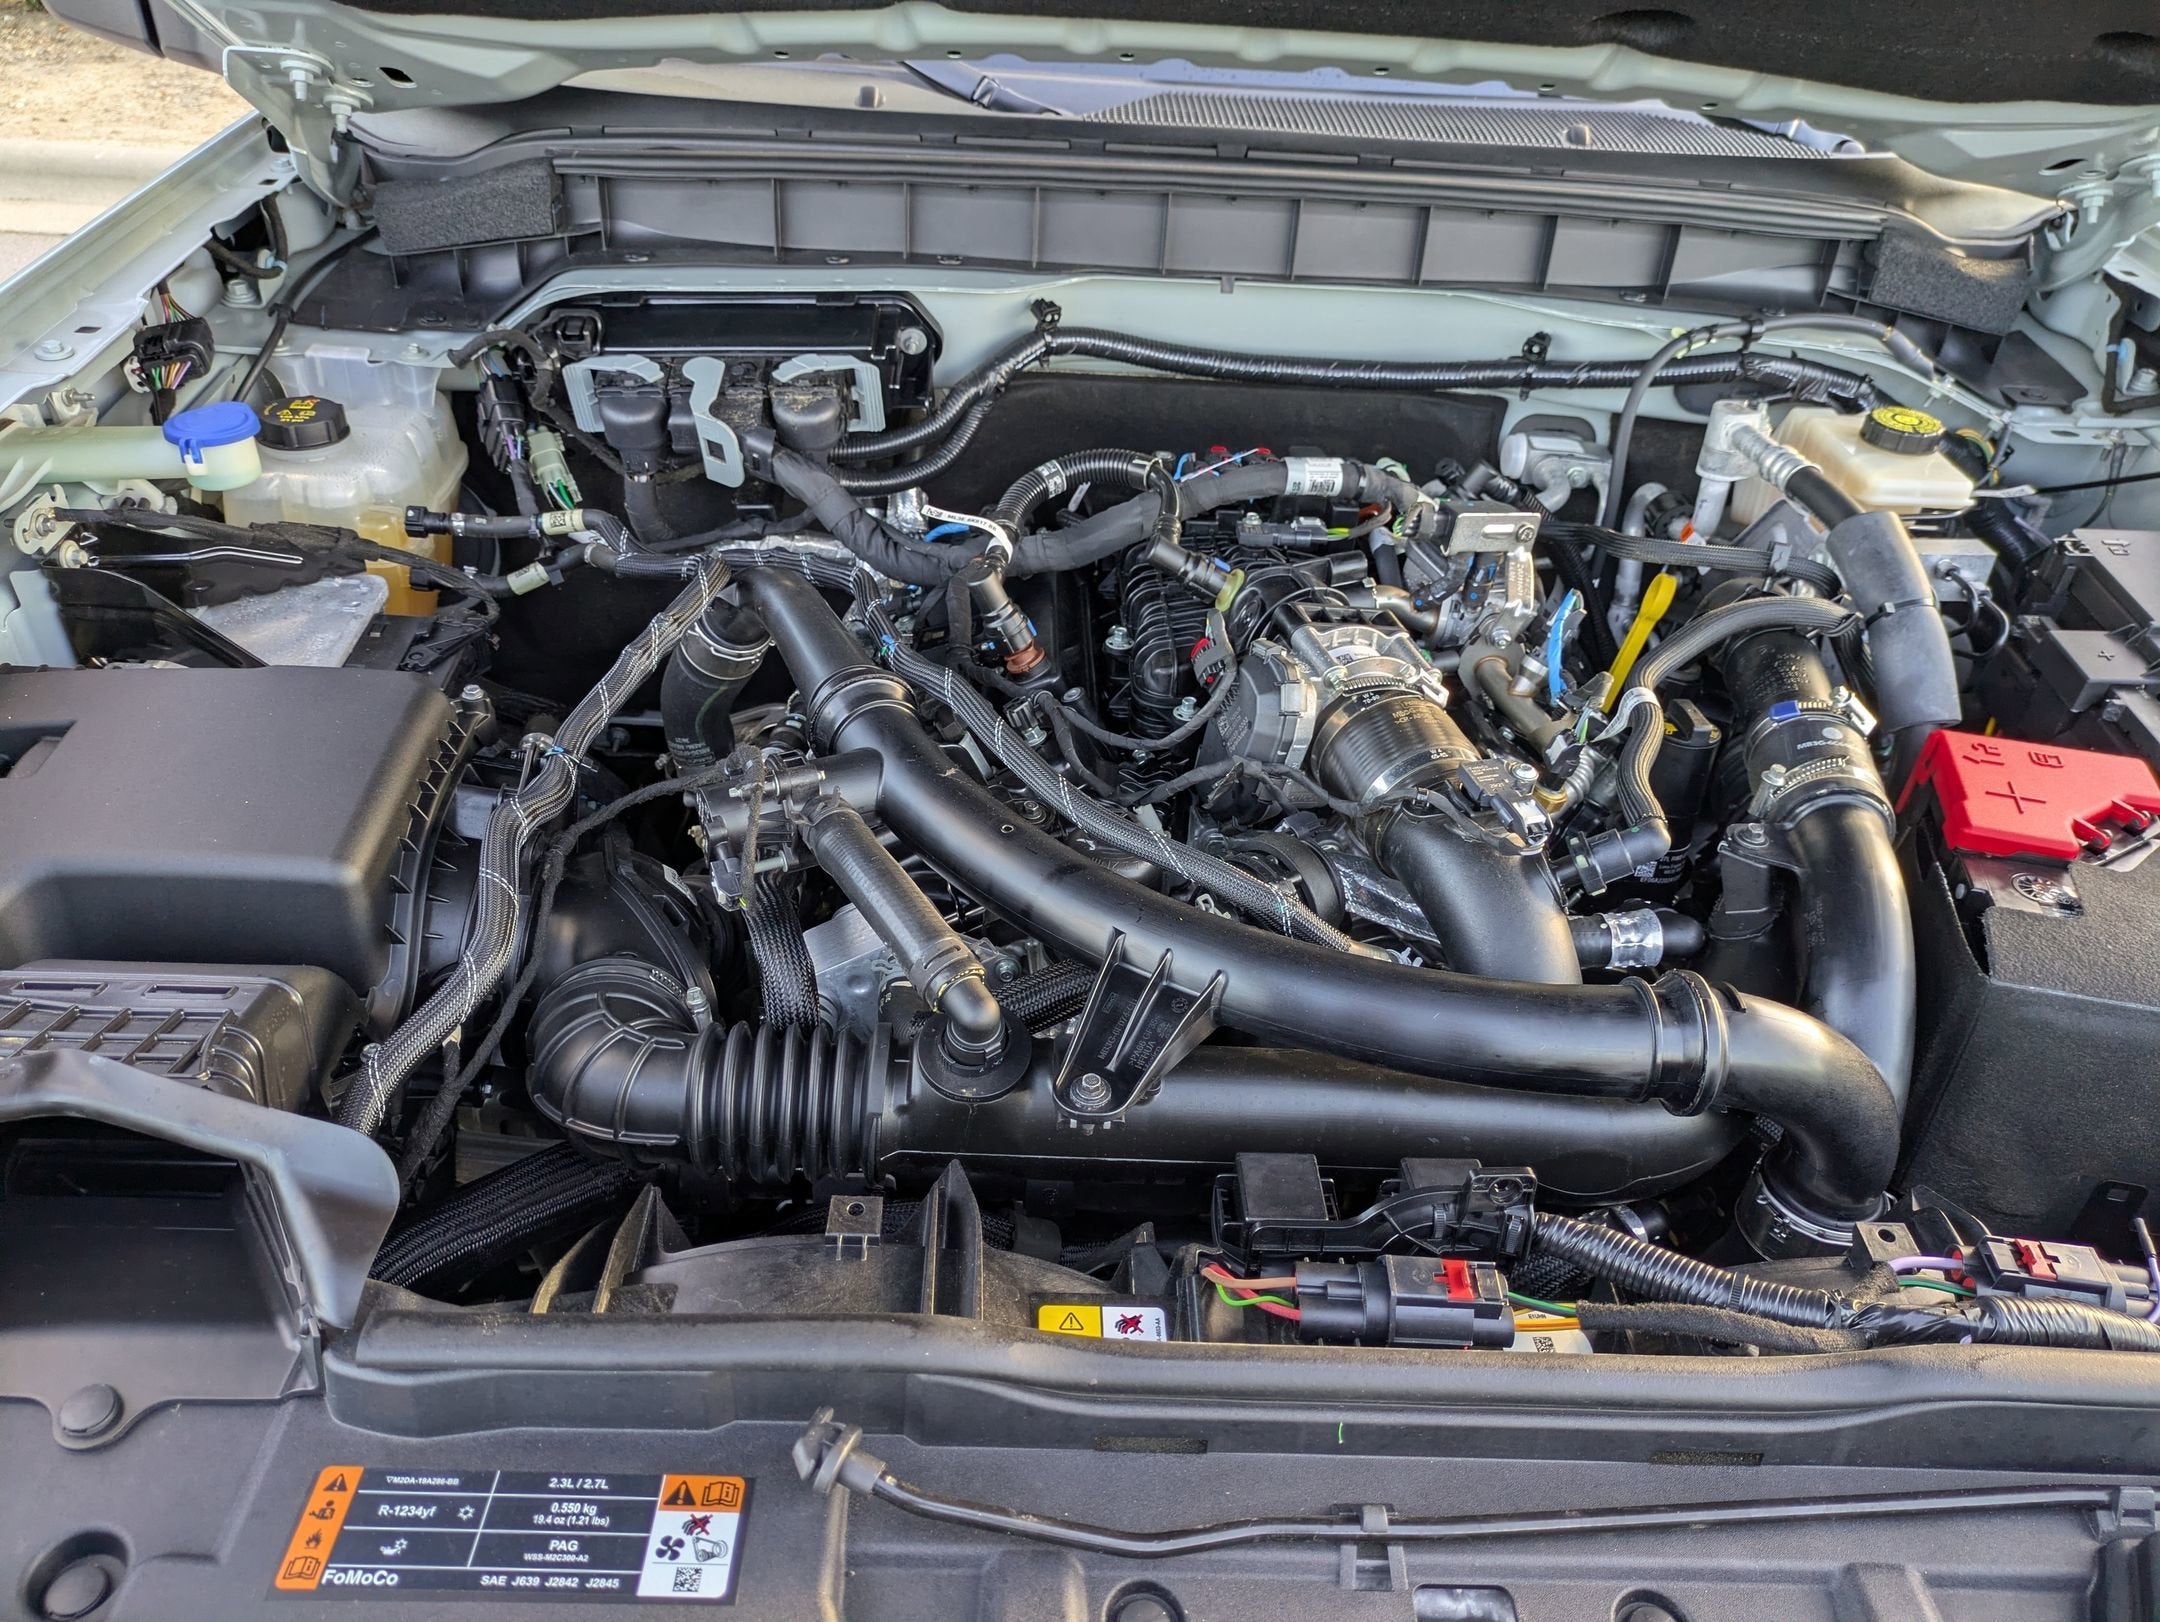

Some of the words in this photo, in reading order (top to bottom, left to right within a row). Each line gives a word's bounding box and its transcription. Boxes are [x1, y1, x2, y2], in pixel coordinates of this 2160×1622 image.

[548, 1478, 575, 1488] 2.3L
[583, 1479, 609, 1489] 2.7L
[378, 1504, 437, 1519] R-1234yf
[550, 1502, 581, 1513] 0.550
[583, 1503, 597, 1516] kg
[533, 1514, 552, 1525] 19.4
[553, 1517, 565, 1525] oz
[567, 1515, 589, 1527] (1.21
[591, 1516, 610, 1527] lbs)
[549, 1540, 578, 1551] PAG
[321, 1569, 399, 1586] FoMoCo
[480, 1575, 507, 1586] SAE
[511, 1576, 540, 1587] J639
[544, 1576, 579, 1588] J2842
[585, 1578, 620, 1589] J2845
